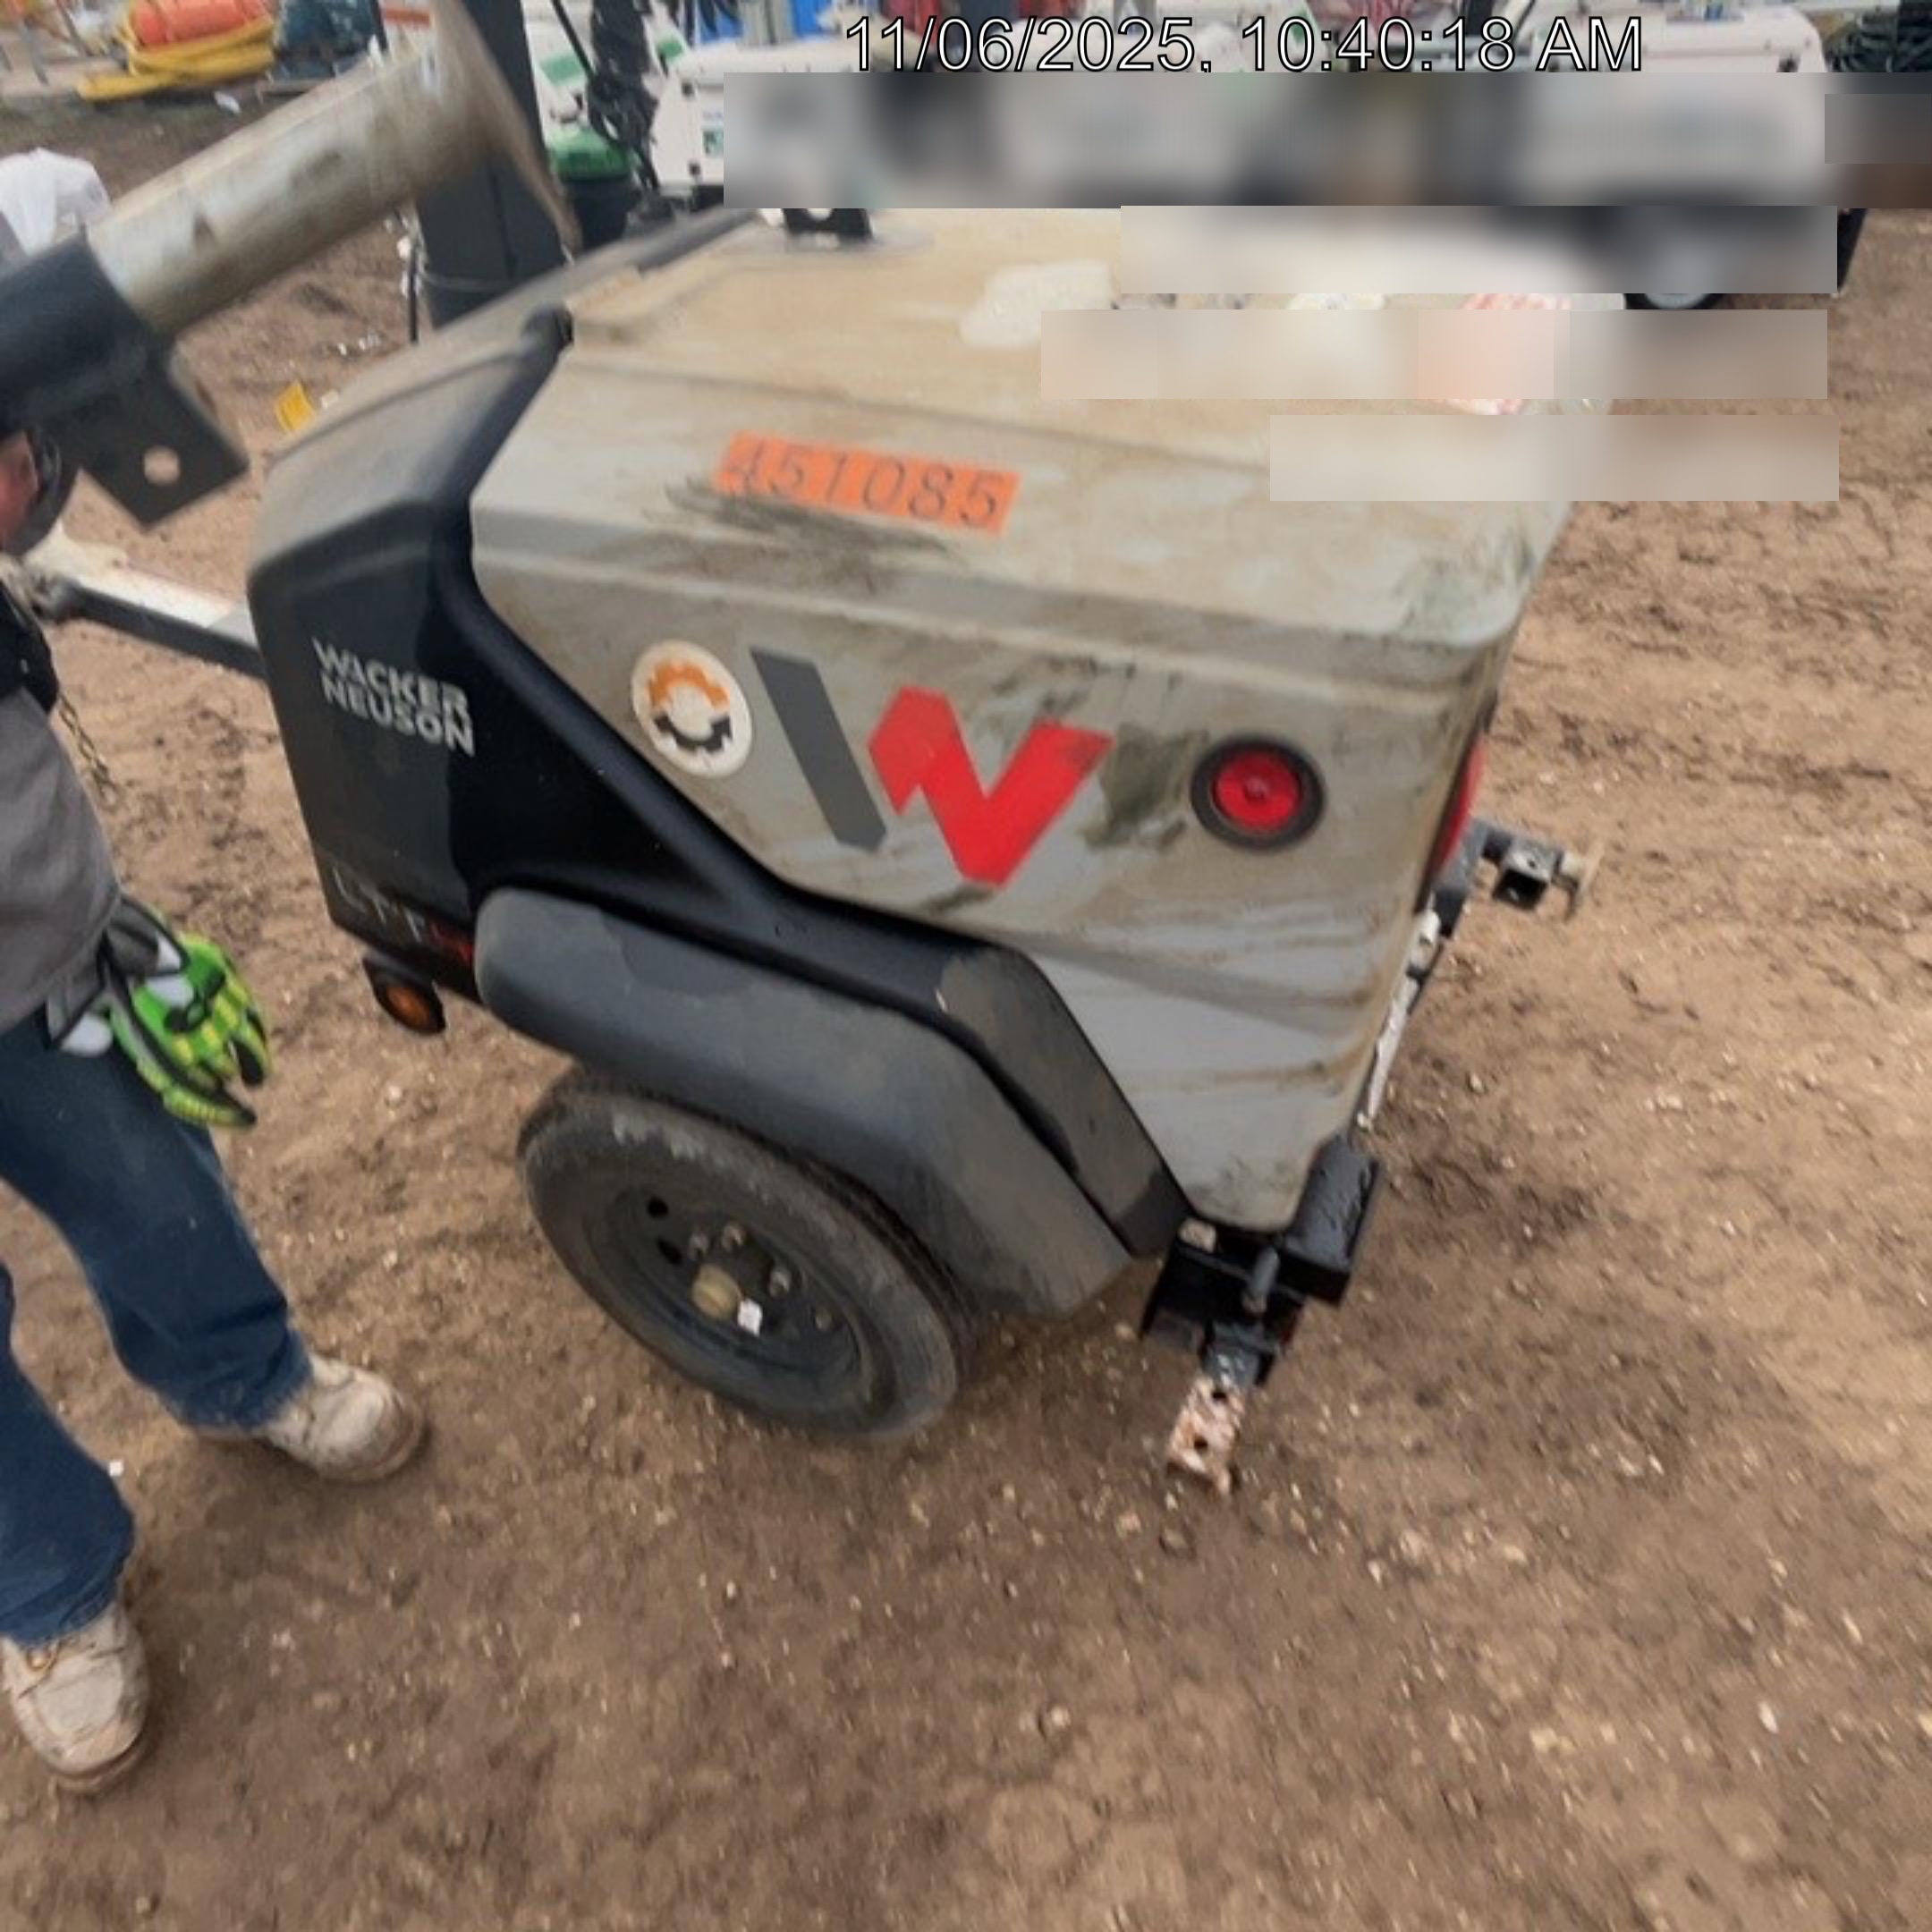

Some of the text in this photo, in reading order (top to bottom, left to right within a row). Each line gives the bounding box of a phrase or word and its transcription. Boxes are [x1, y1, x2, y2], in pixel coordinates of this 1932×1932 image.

[719, 438, 1005, 530] 451085
[312, 636, 468, 715] WACKER
[319, 672, 475, 757] NEUSON
